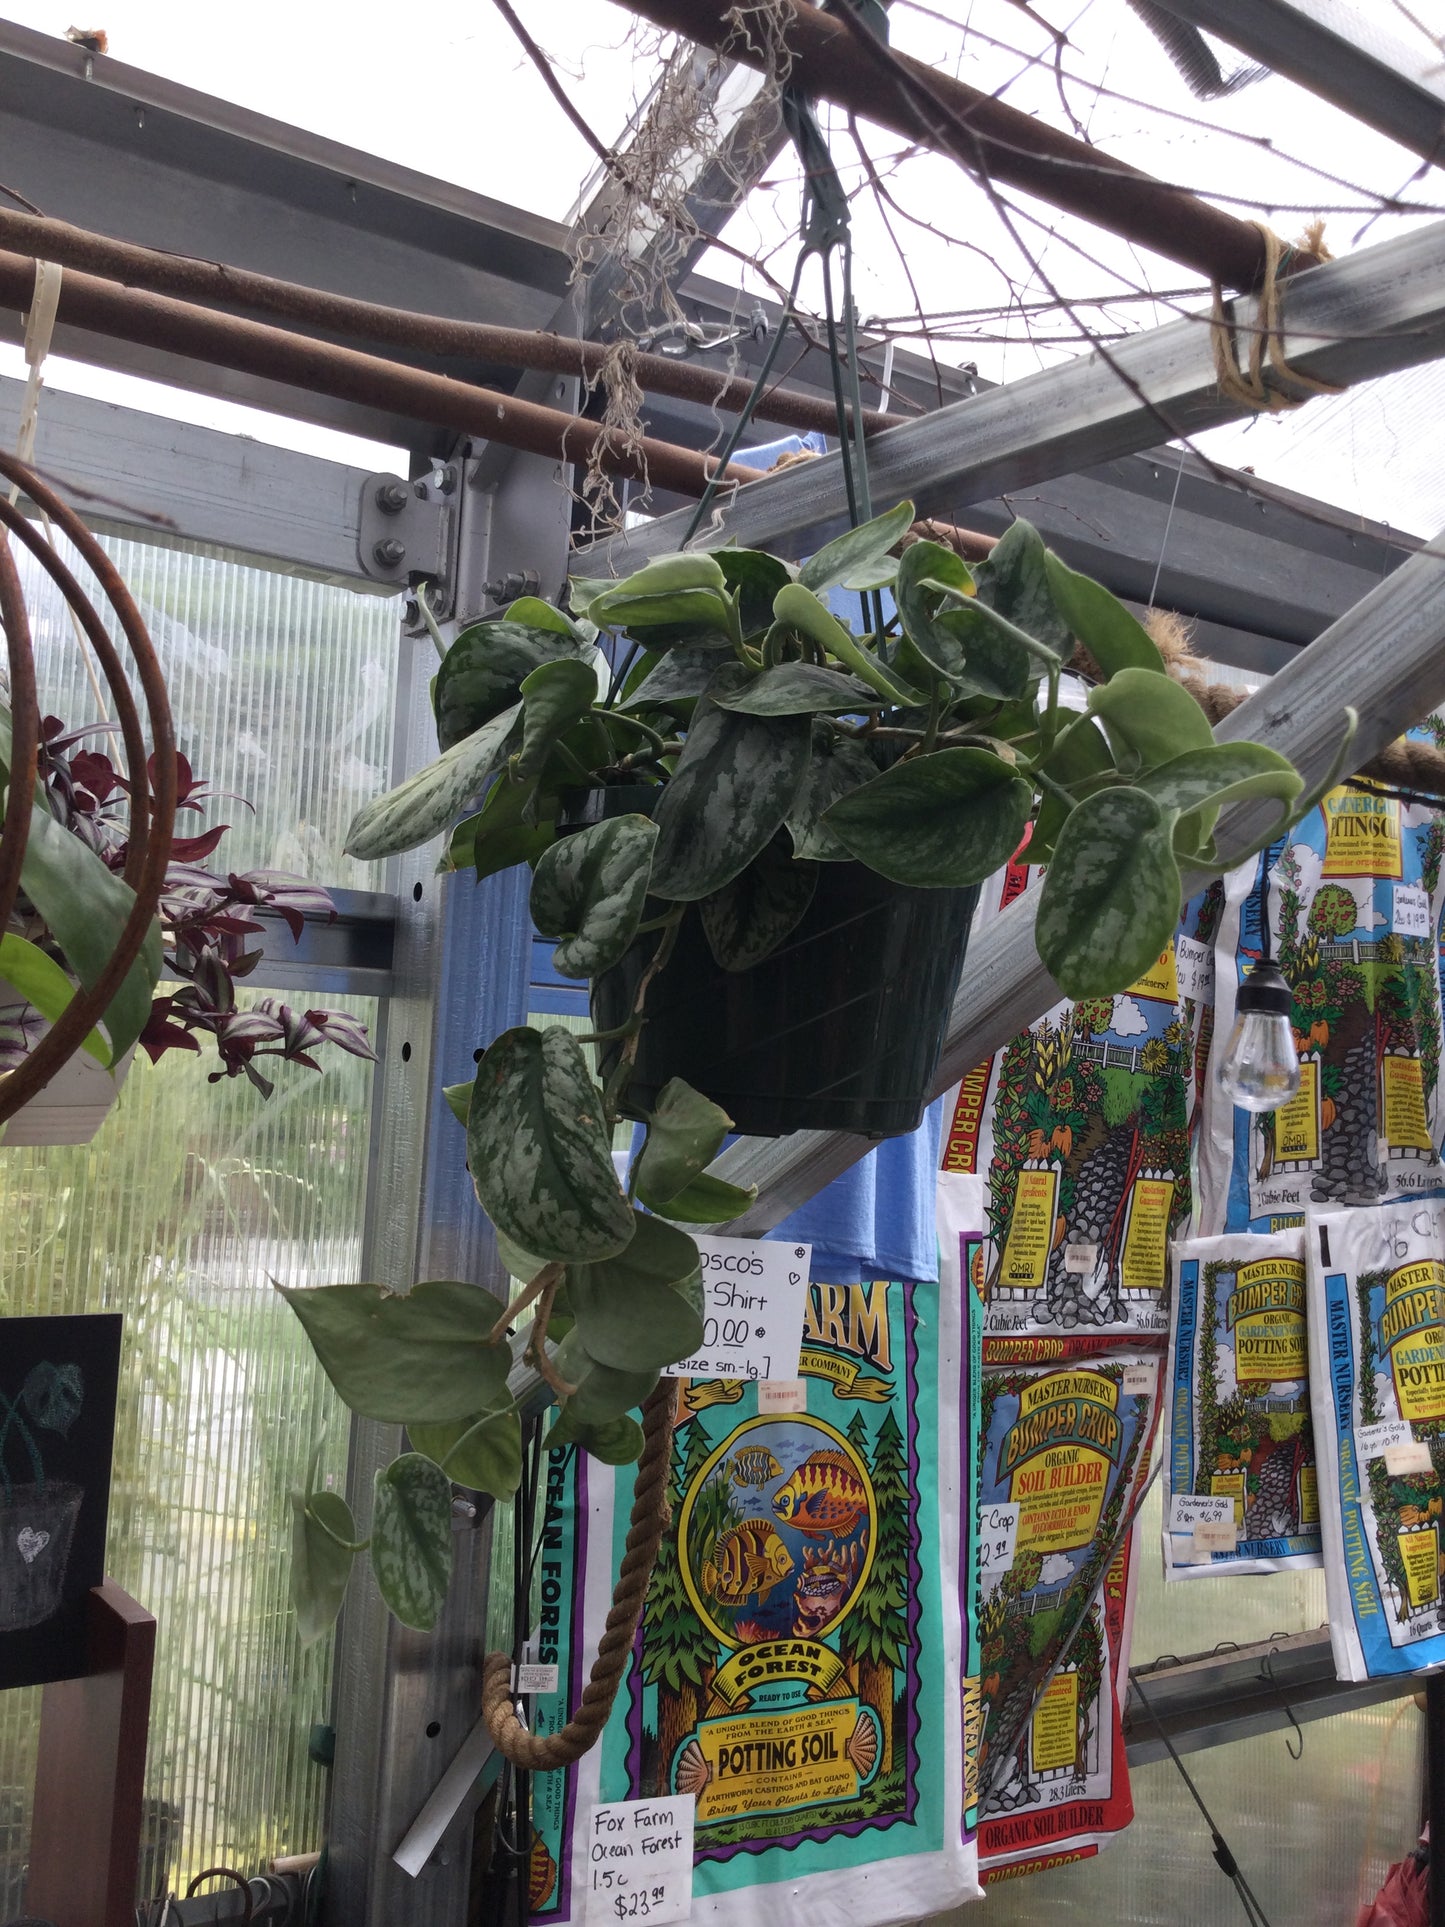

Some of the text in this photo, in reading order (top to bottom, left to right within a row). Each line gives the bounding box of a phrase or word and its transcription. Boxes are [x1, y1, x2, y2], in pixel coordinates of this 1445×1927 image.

[1180, 939, 1205, 968] Bumper
[1282, 1189, 1300, 1203] Feet
[699, 1249, 764, 1276] osco's
[1010, 1262, 1033, 1273] OMRI
[1243, 1263, 1278, 1282] MASTER
[1389, 1268, 1430, 1296] MASTER
[1181, 1279, 1194, 1326] MASTER
[1231, 1281, 1287, 1319] BUMPER
[801, 1281, 894, 1373] ARM
[990, 1315, 1012, 1331] Cubic
[1012, 1314, 1029, 1331] Feet
[1263, 1312, 1292, 1325] ORGANIC
[1382, 1290, 1438, 1346] BUMPE
[703, 1317, 749, 1348] 0.00
[1238, 1338, 1288, 1354] POTTING
[985, 1338, 1064, 1362] BUMPER CROP
[1178, 1329, 1192, 1382] NURSERY
[810, 1355, 853, 1380] COMPANY
[1027, 1379, 1071, 1409] MASTER
[1071, 1378, 1112, 1404] NURSERY
[1175, 1387, 1188, 1439] ORGANIC
[1006, 1402, 1118, 1466] BUMPER CROP
[1388, 1423, 1405, 1432] Gold
[1044, 1448, 1080, 1468] ORGANIC
[1330, 1300, 1378, 1619] MASTER NURSERY ORGANIC POTTING SOIL
[1018, 1461, 1103, 1496] SOIL BUILDER
[1022, 1510, 1050, 1526] CONTAINS
[1051, 1507, 1067, 1520] ECTO
[1073, 1504, 1091, 1516] ENDO
[1178, 1496, 1228, 1509] Gardener's Gold
[990, 1510, 1015, 1533] Crop
[538, 1445, 566, 1665] OCEAN FORES
[1244, 1540, 1286, 1557] NURSERY
[738, 1643, 821, 1667] OCEAN
[734, 1660, 822, 1687] FOREST
[759, 1690, 801, 1702] READY TO USE
[705, 1708, 850, 1736] "A UNIQUE BLEND OF GOOD THINGS
[726, 1730, 751, 1740] FROM
[755, 1727, 774, 1736] THE
[777, 1723, 805, 1734] EARTH
[815, 1717, 835, 1727] SEA"
[718, 1731, 838, 1777] POTTING SOIL
[554, 1777, 562, 1799] GOOD
[706, 1772, 850, 1803] EARTHWORM CASTINGS AND BAT GUANO
[756, 1771, 803, 1785] CONTAINS
[707, 1782, 850, 1817] Bring Your Plants to Life!
[1049, 1784, 1087, 1803] 28.3 Liters
[553, 1802, 561, 1831] THINGS
[595, 1807, 674, 1835] Fox Farm
[985, 1806, 1104, 1849] ORGANIC SOIL BUILDER
[591, 1830, 682, 1862] Ocean Forest
